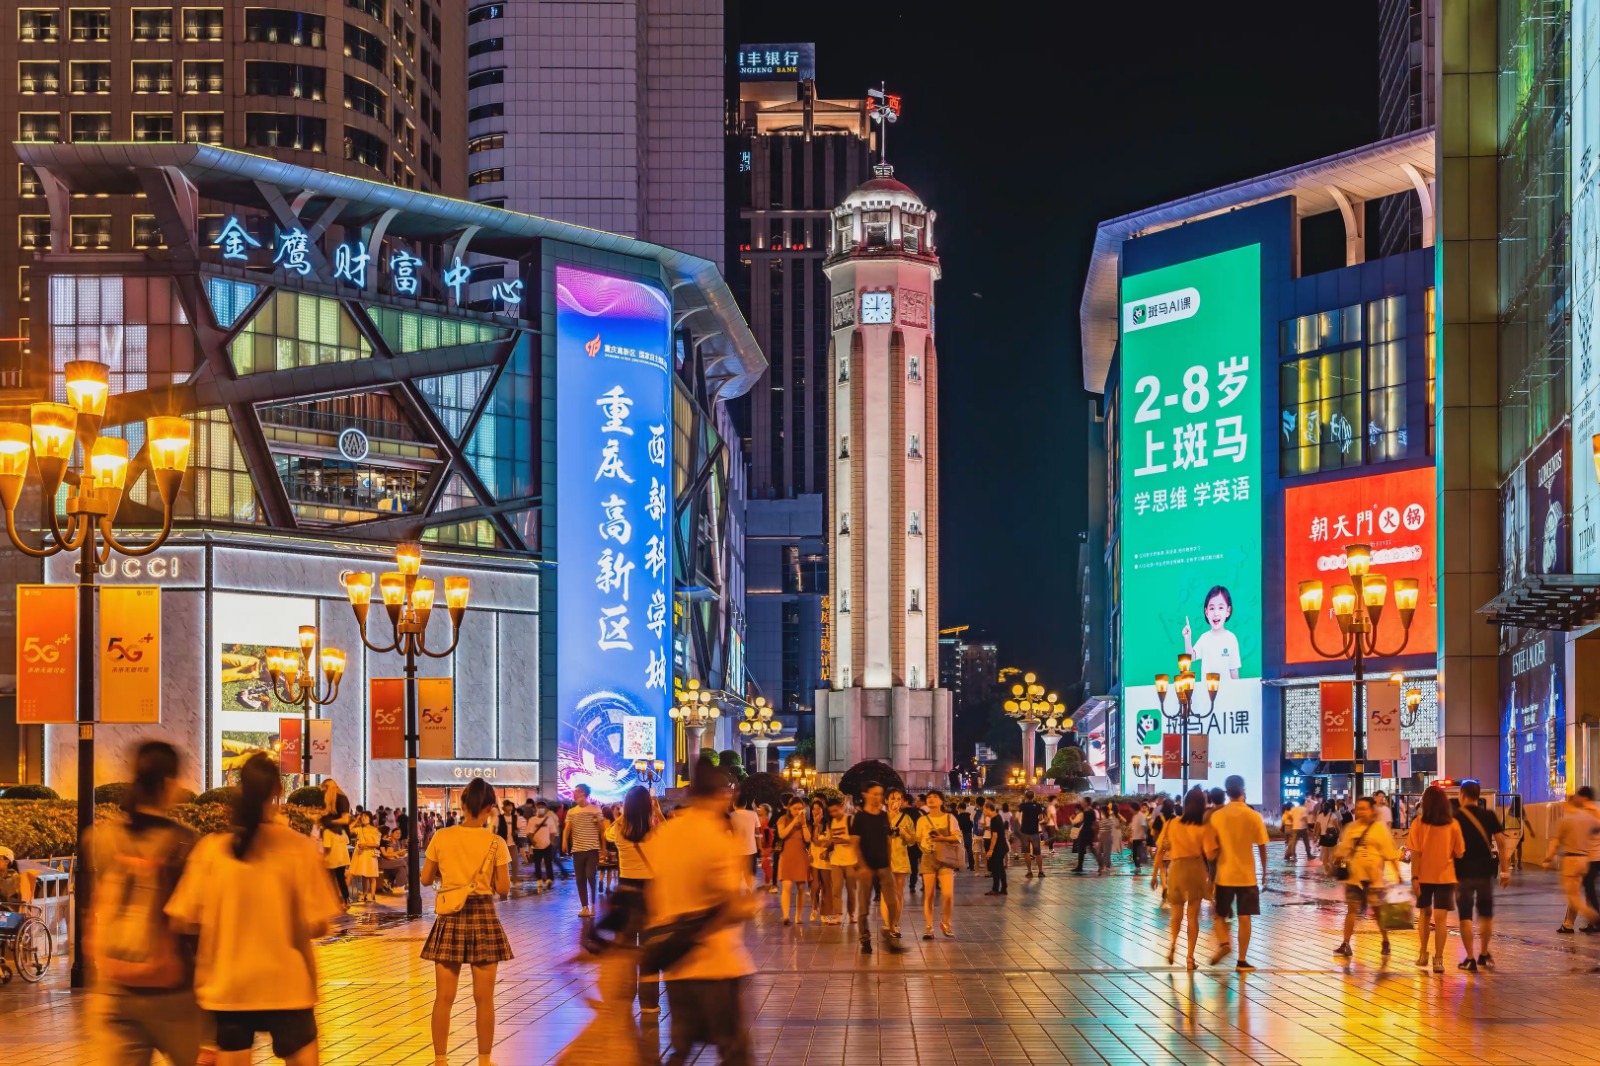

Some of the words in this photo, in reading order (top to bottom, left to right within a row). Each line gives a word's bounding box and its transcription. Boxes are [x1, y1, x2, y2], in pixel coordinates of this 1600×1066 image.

[214, 216, 524, 305] 金鹰财富中心
[1148, 297, 1191, 319] 斑马AI课
[1134, 356, 1249, 424] 2-8岁
[1134, 415, 1248, 477] 上斑马
[1538, 448, 1563, 487] LONGINES
[1134, 485, 1187, 516] 学思维
[1194, 476, 1250, 507] 学英语
[594, 385, 636, 651] 重庆高新区
[75, 557, 180, 578] UCCI
[454, 767, 498, 779] GUCCI
